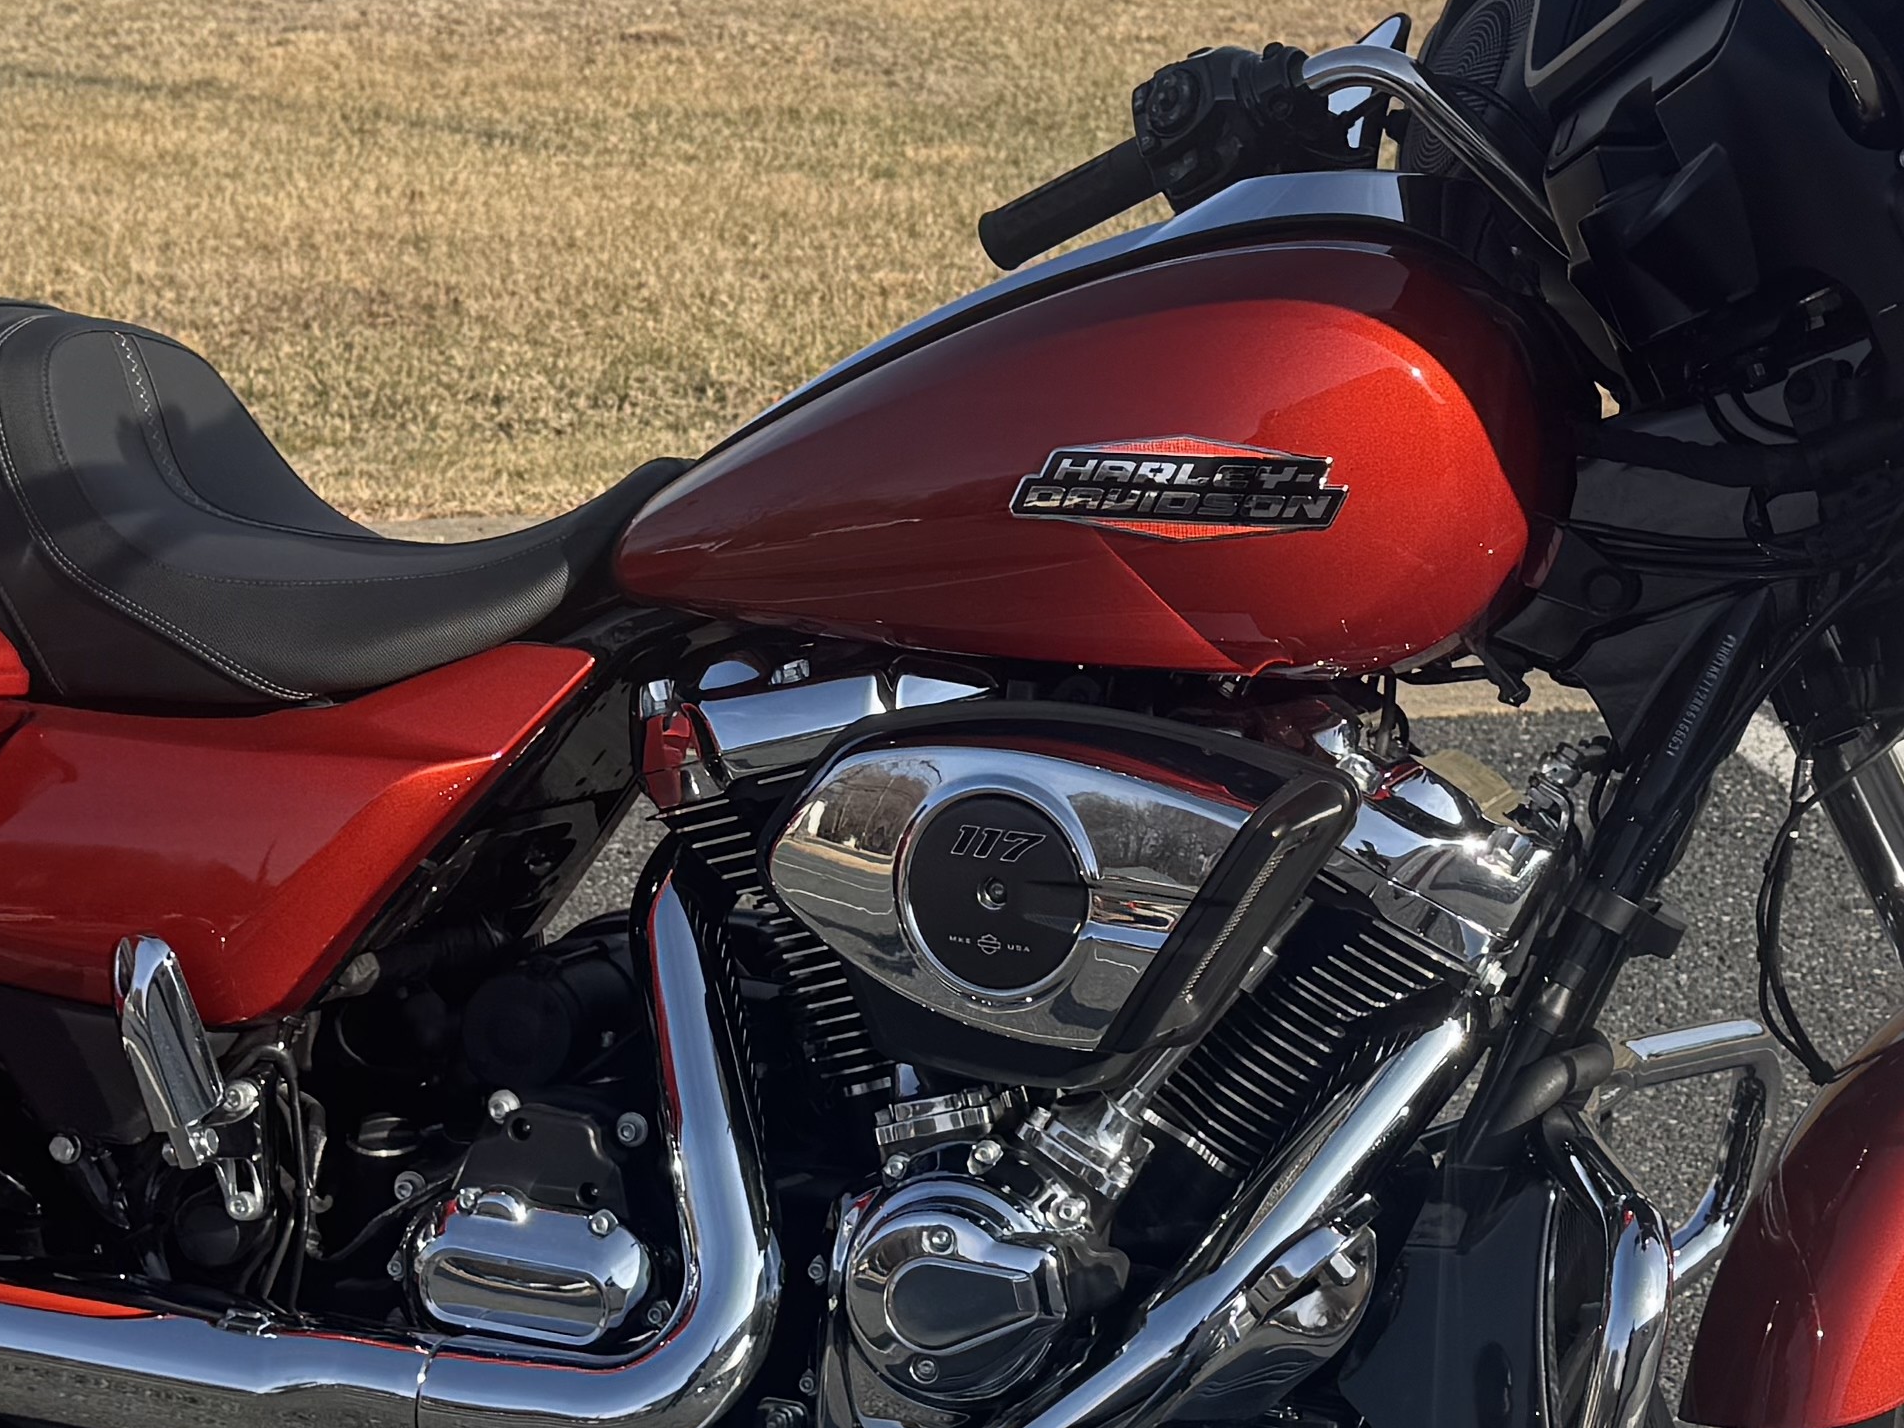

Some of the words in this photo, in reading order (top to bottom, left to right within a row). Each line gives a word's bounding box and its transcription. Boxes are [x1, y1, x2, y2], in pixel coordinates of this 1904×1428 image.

[1052, 457, 1315, 490] HARLEY-
[1022, 484, 1332, 519] DAVIDSON
[950, 823, 1046, 863] 117
[1006, 943, 1030, 952] USA
